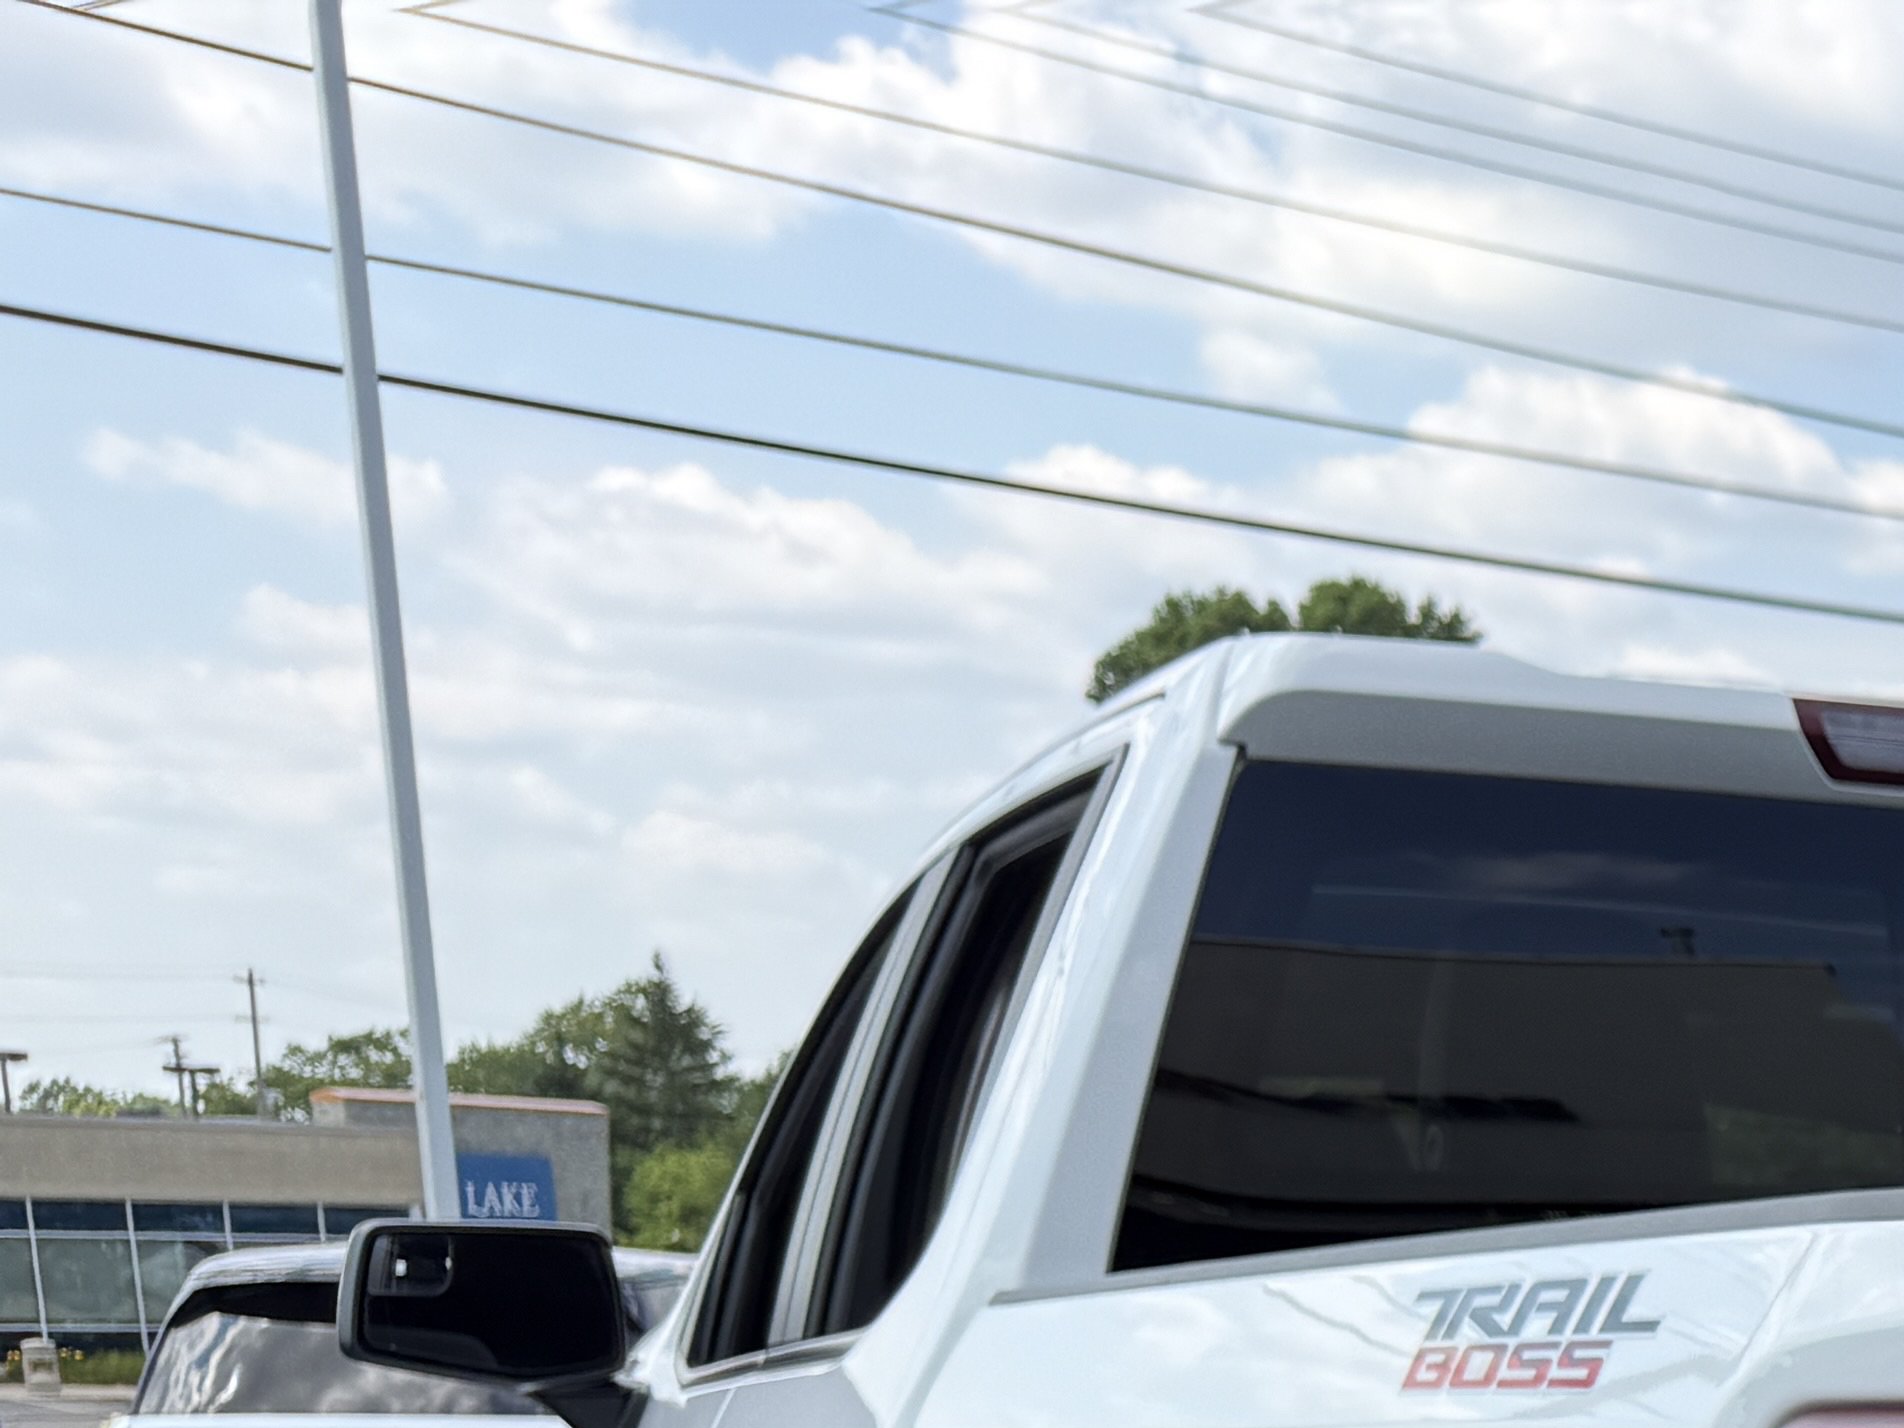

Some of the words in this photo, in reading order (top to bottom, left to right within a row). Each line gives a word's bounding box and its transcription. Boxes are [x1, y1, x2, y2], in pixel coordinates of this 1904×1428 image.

[464, 1180, 540, 1218] LAKE
[1415, 1274, 1662, 1343] TRAIL
[1402, 1340, 1614, 1389] BOSS
